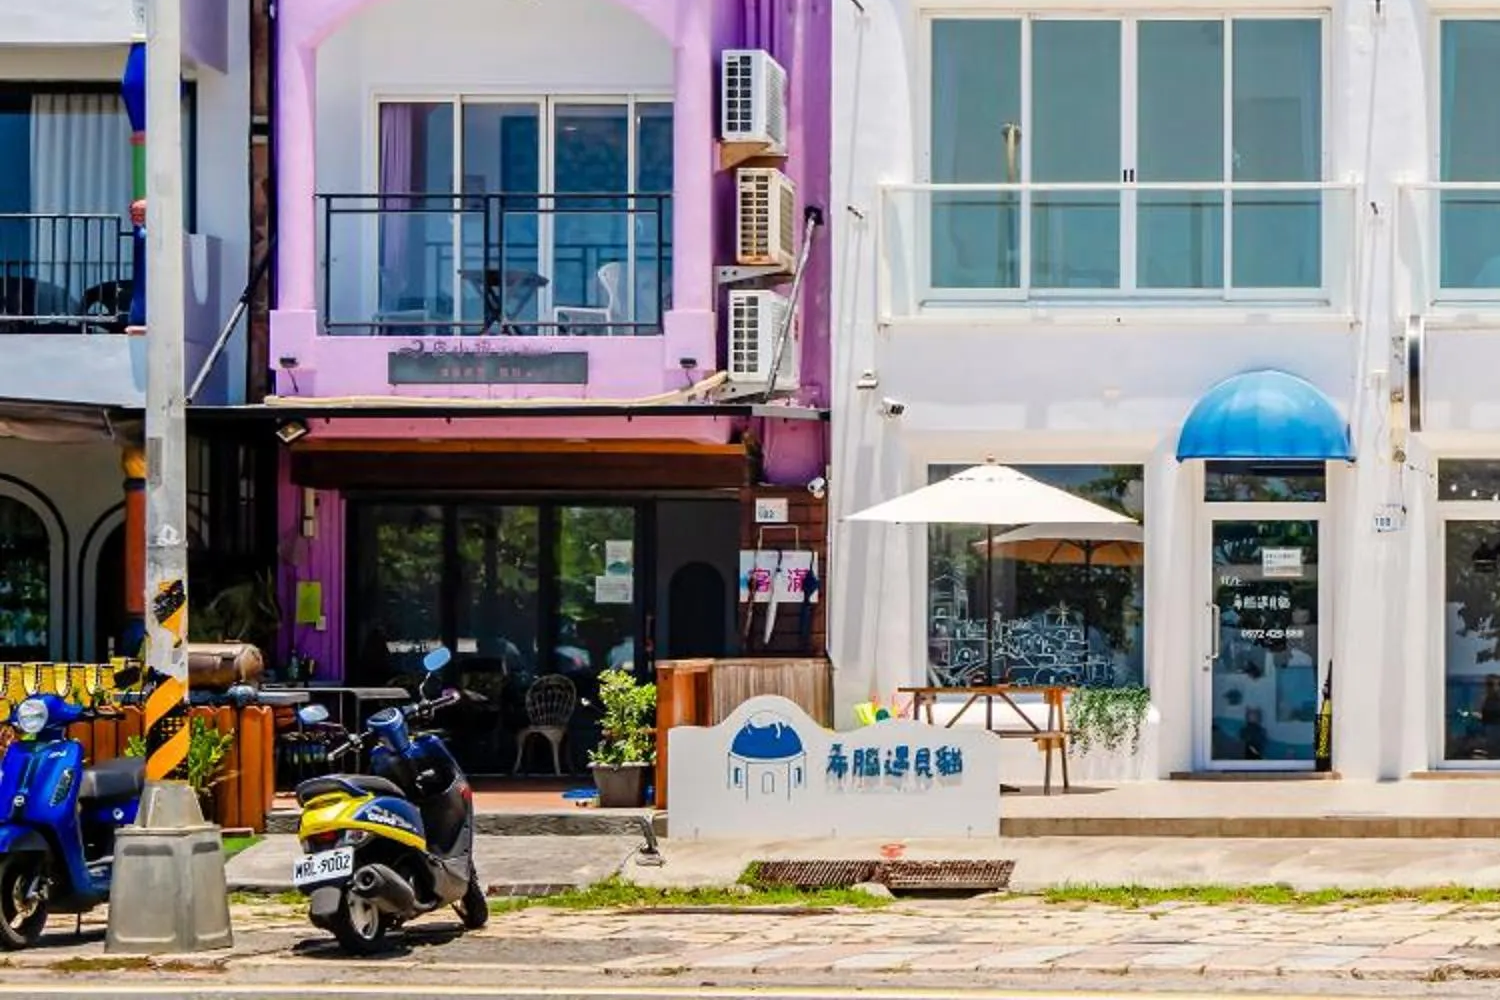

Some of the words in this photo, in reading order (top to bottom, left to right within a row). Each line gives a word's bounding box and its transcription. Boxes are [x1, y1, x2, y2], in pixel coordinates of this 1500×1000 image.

[826, 743, 963, 779] 希臘遇見貓
